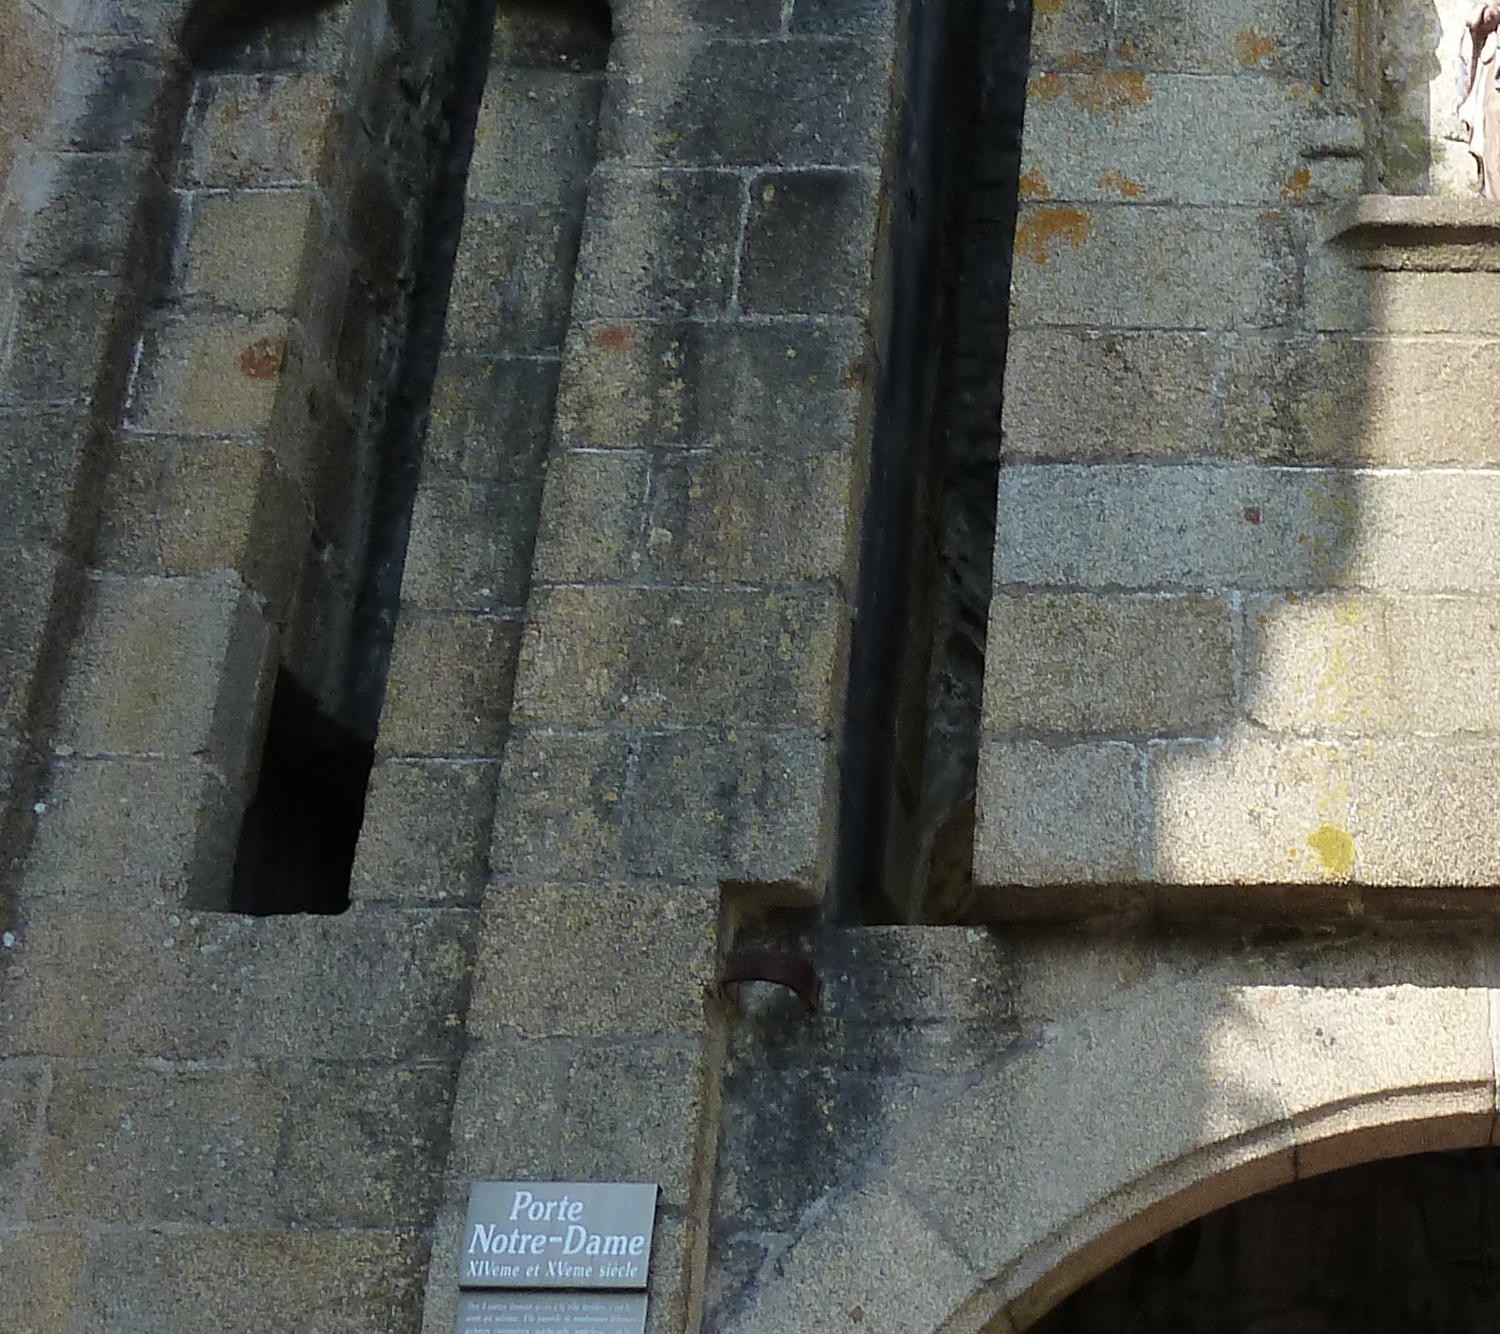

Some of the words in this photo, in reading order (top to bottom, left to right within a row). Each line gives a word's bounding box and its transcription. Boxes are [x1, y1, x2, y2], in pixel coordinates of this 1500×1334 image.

[509, 1191, 583, 1222] Porte
[468, 1224, 645, 1255] Notre-Dame
[526, 1263, 540, 1277] et
[599, 1261, 638, 1278] siècle
